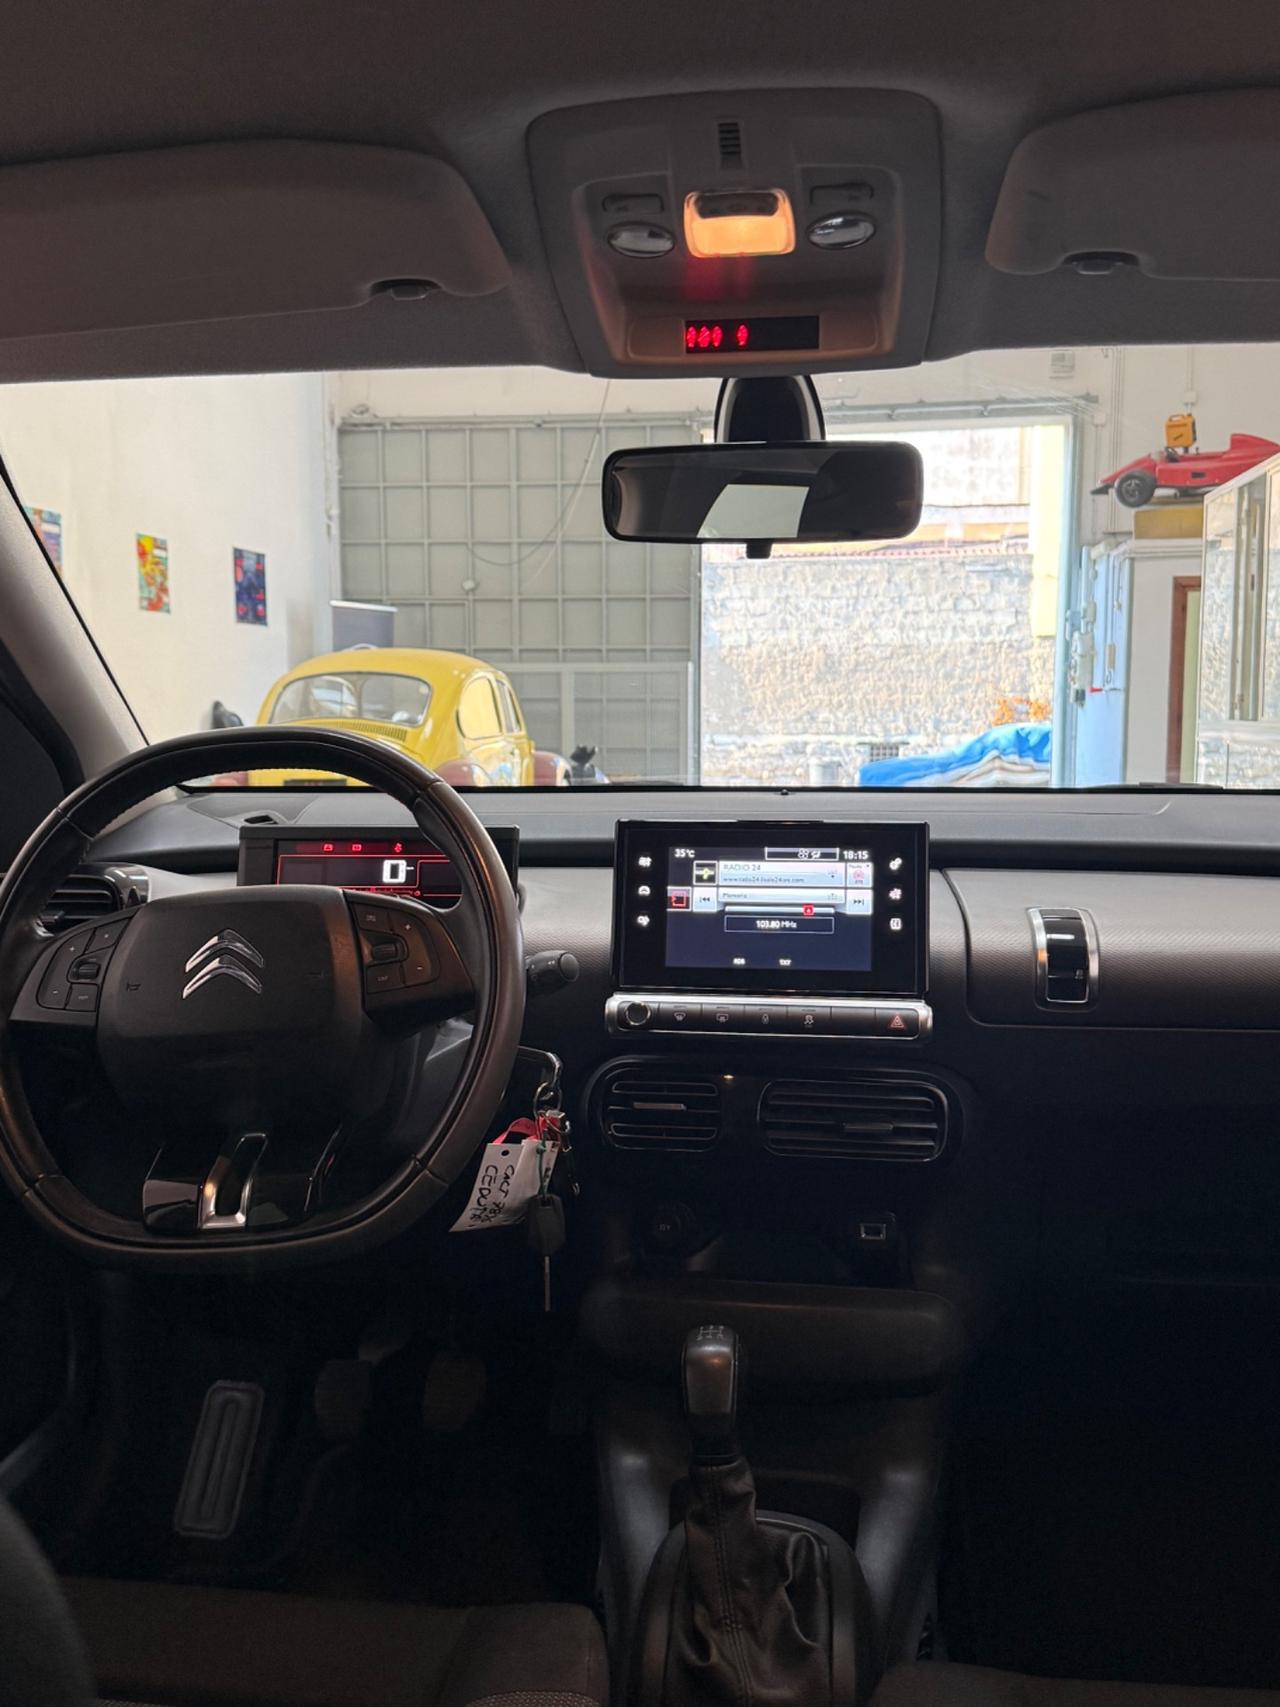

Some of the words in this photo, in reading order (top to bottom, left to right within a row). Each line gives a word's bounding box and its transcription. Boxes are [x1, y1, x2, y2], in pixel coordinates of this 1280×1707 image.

[674, 848, 696, 858] 35°C
[843, 850, 869, 860] 18:15
[723, 863, 751, 871] RADIO
